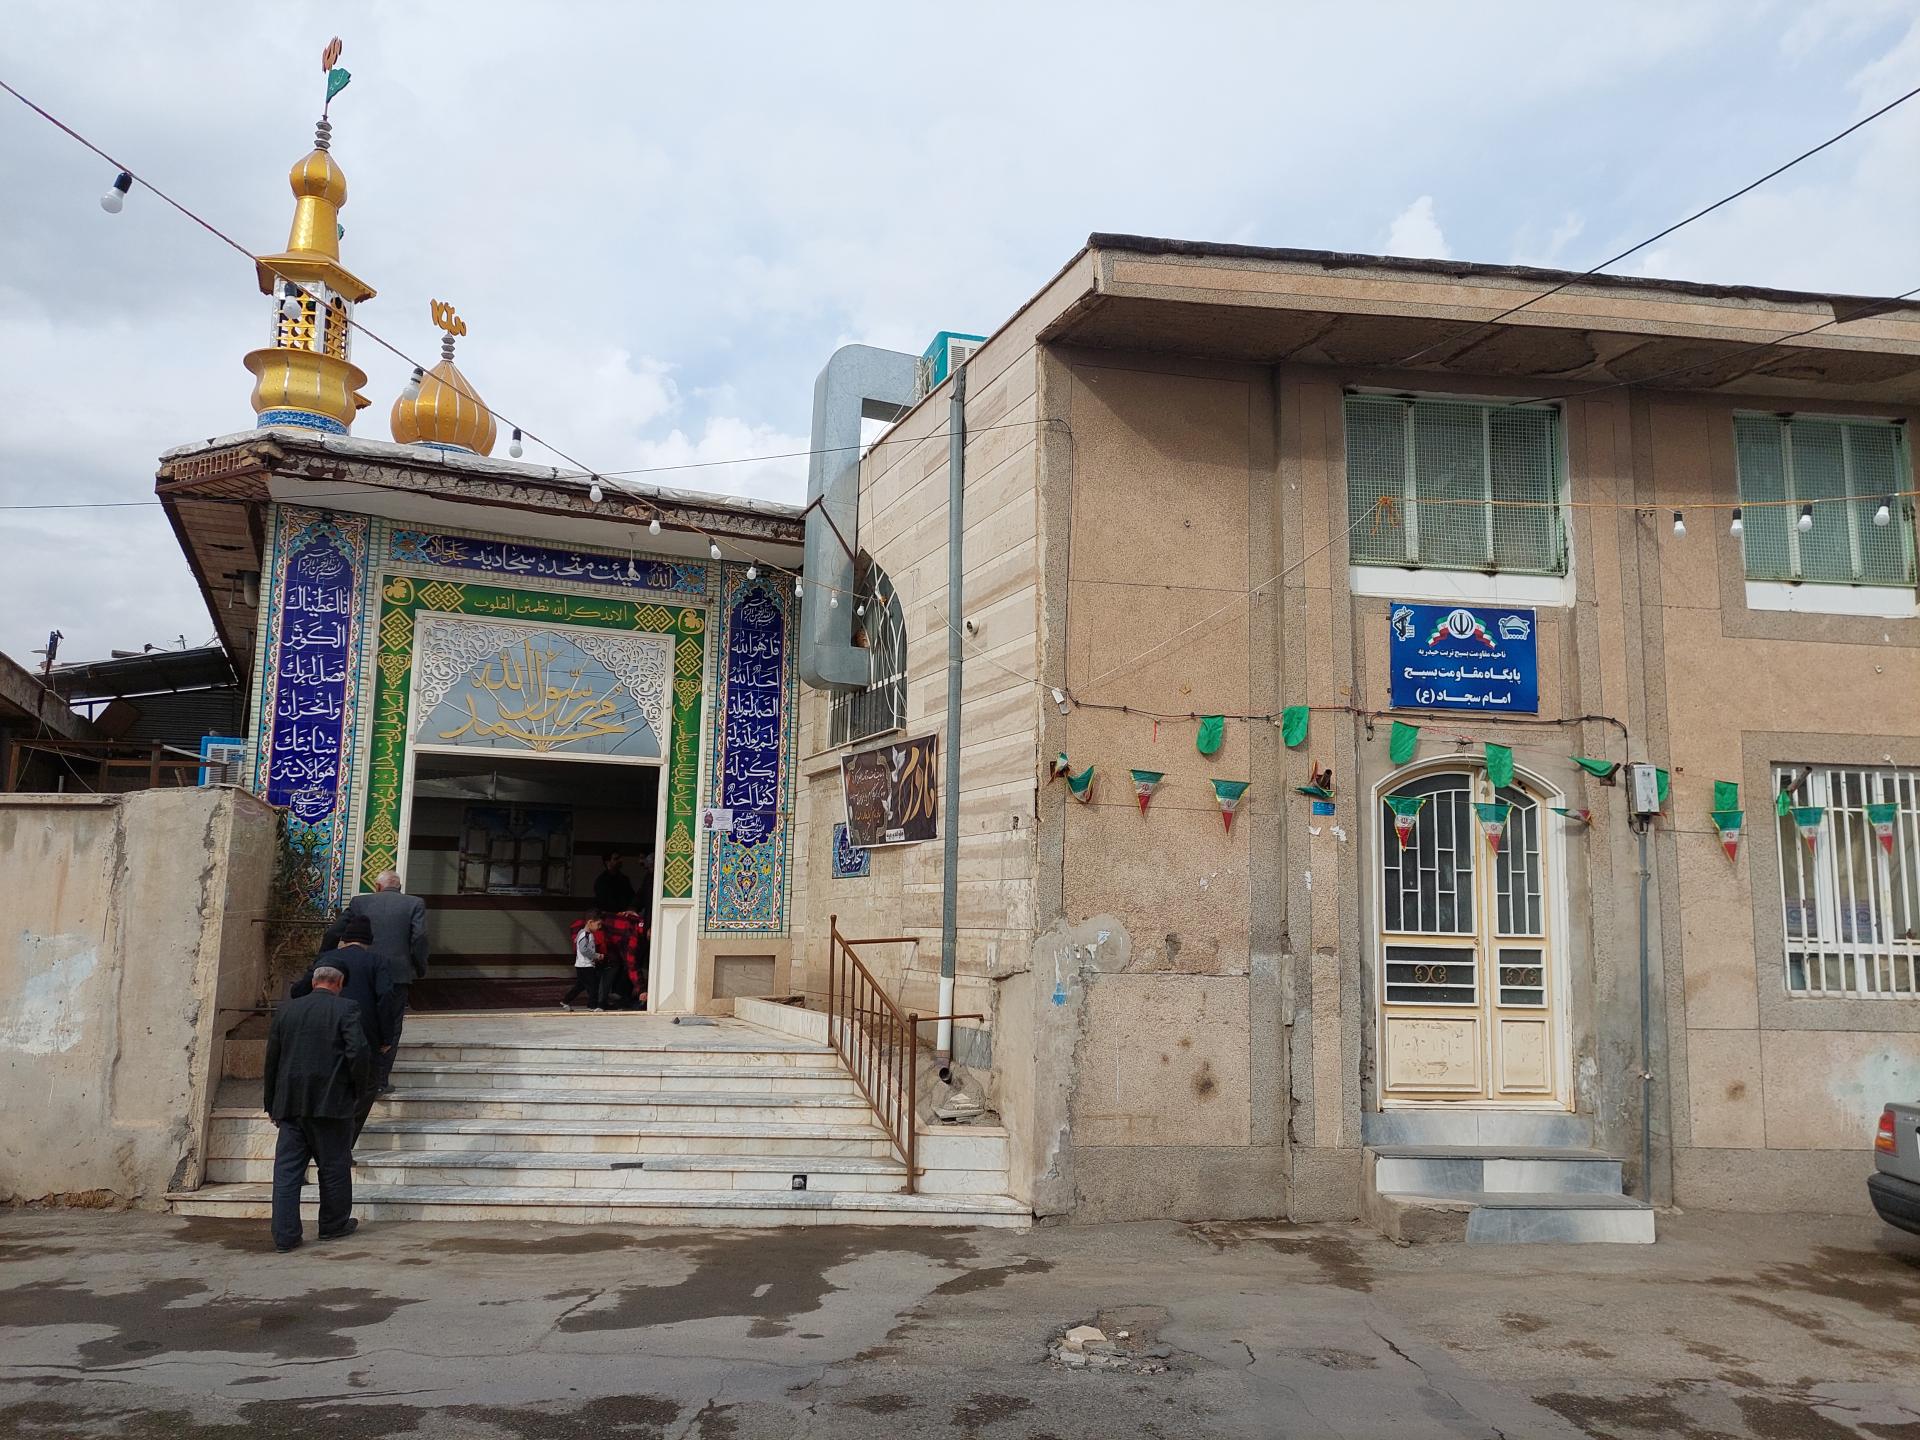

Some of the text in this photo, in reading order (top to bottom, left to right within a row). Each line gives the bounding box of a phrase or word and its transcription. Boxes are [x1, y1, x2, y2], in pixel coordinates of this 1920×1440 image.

[1469, 650, 1491, 660] مقاومت
[1404, 666, 1521, 684] پایگاه مقاومت بسیج
[1415, 688, 1511, 706] امام سجاد (ع)
